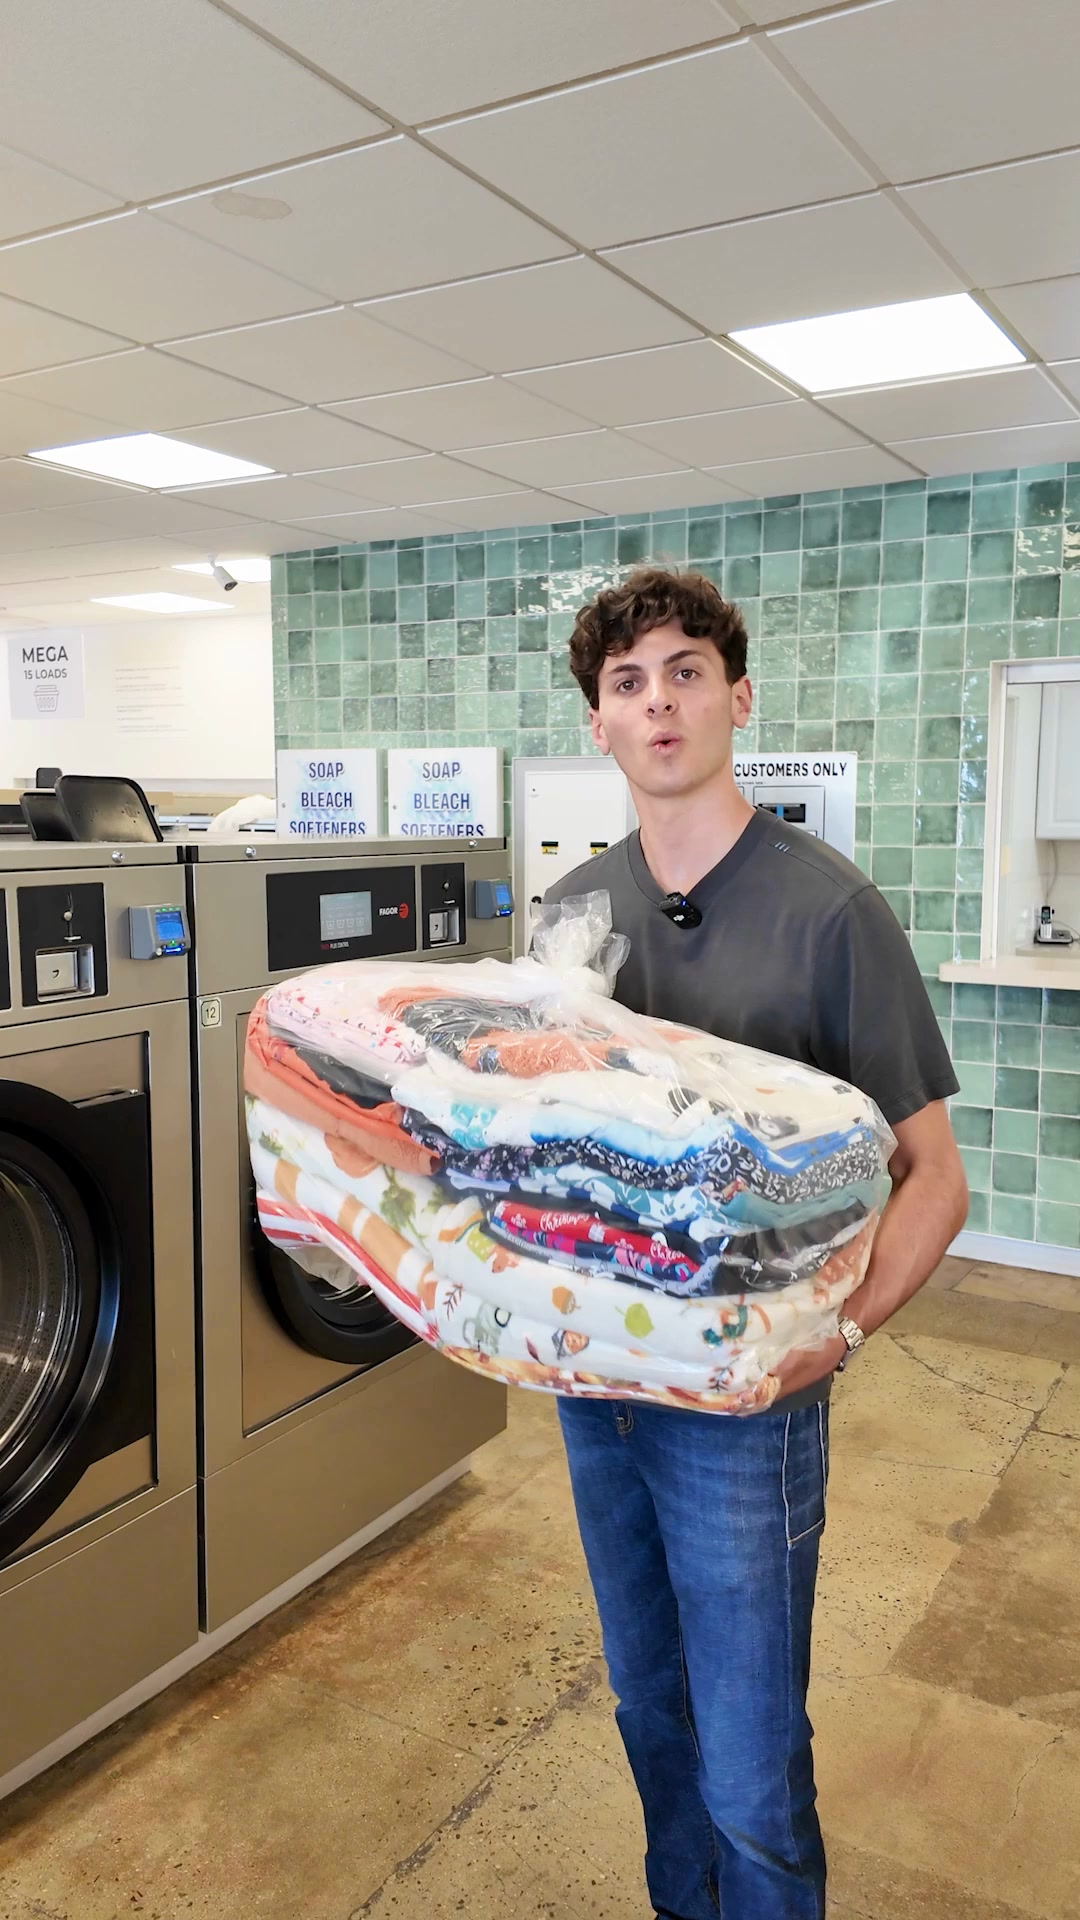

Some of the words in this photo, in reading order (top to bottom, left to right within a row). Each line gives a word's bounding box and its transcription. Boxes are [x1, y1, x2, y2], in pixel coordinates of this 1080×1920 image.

[22, 645, 69, 663] MEGA
[24, 669, 33, 680] 15
[35, 668, 68, 679] LOADS
[308, 762, 344, 778] SOAP
[422, 761, 461, 779] SOAP
[733, 762, 809, 778] CUSTOMERS
[812, 762, 848, 776] ONLY
[301, 791, 353, 808] BLEACH
[413, 792, 470, 810] BLEACH
[379, 906, 398, 916] FAGOR
[205, 1006, 217, 1019] 12
